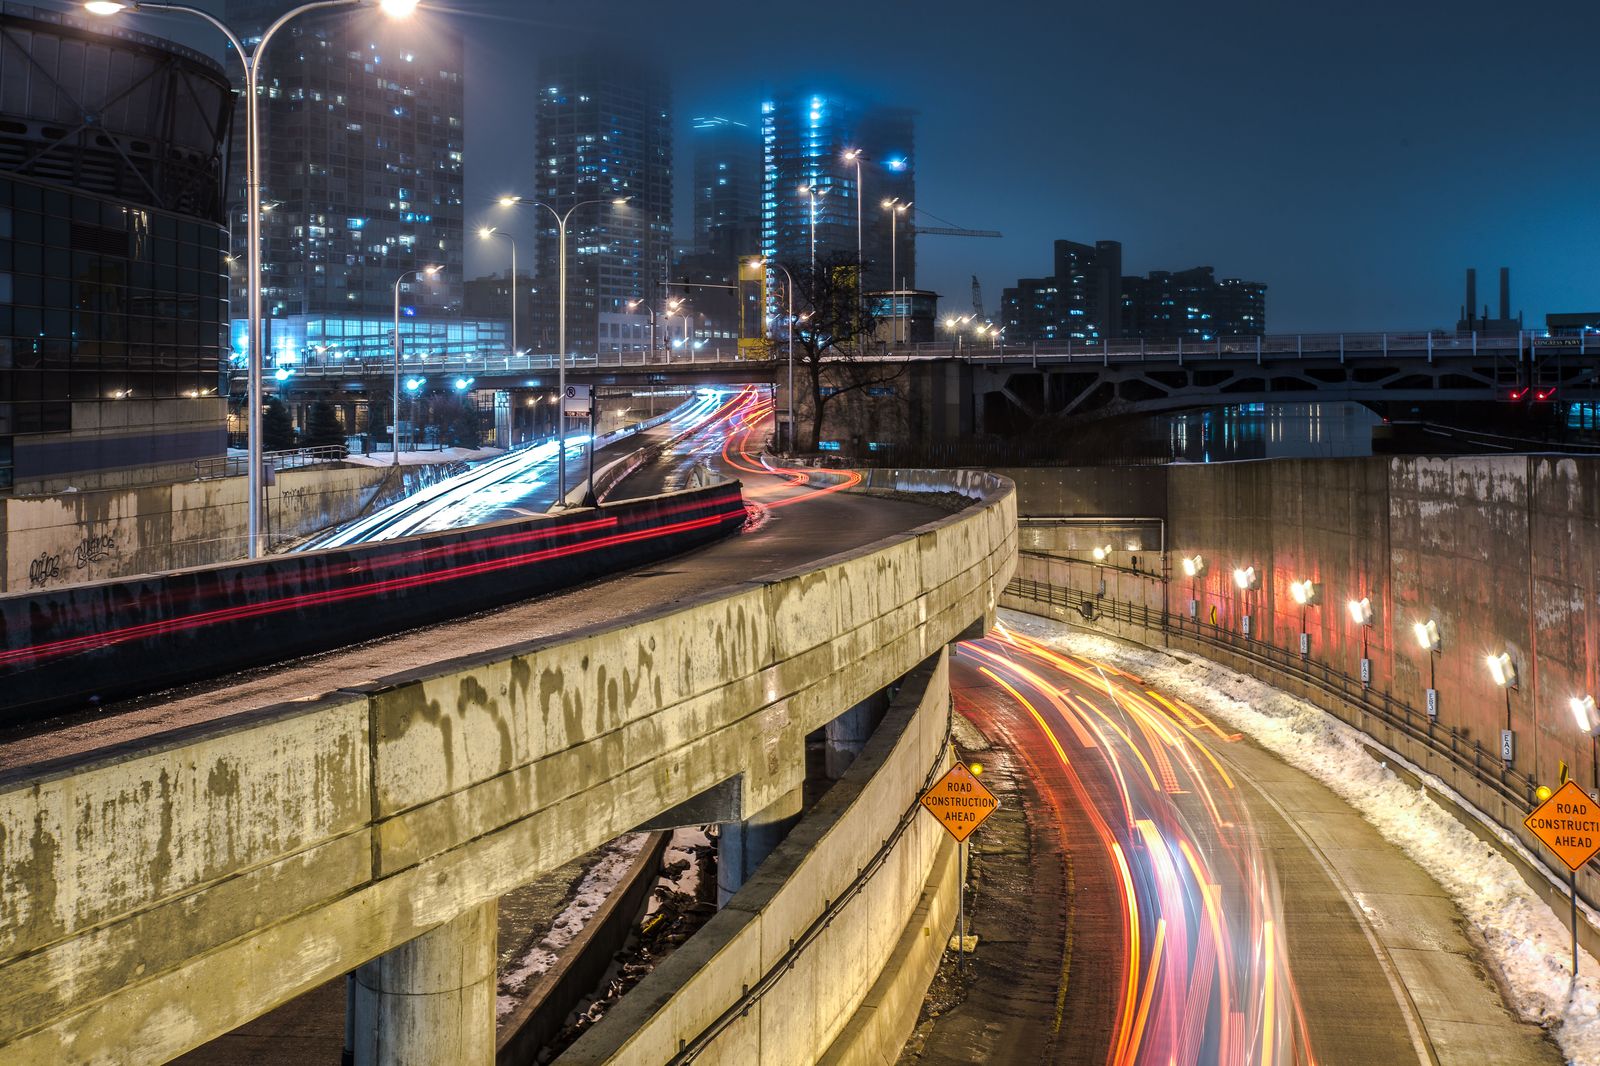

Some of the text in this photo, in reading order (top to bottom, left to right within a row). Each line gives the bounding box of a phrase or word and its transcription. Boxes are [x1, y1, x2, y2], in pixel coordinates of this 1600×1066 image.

[947, 782, 972, 792] ROAD
[925, 796, 995, 808] CONSTRUCTION
[1556, 803, 1587, 815] ROAD
[944, 811, 976, 822] AHEAD
[1530, 818, 1600, 832] CONSTRUCTI
[1554, 835, 1593, 848] AHEAD
